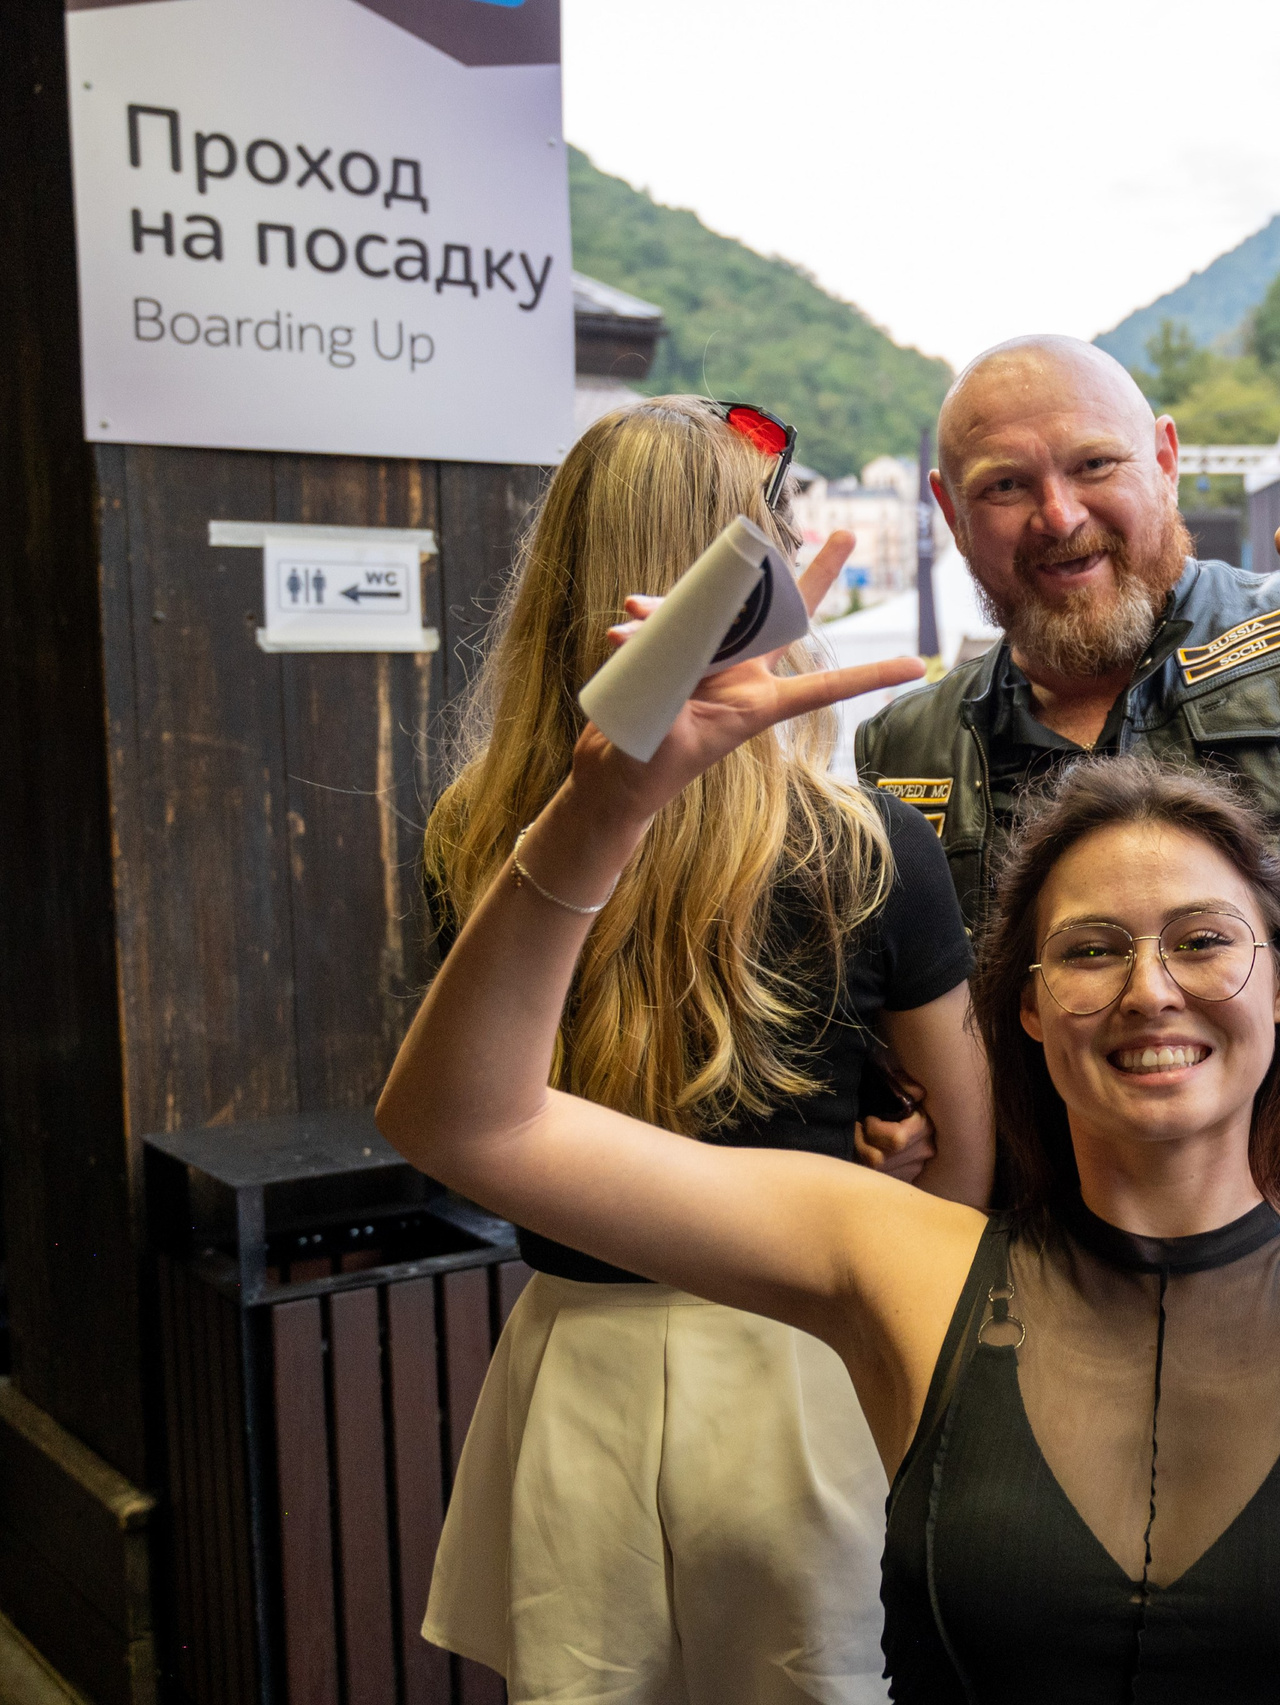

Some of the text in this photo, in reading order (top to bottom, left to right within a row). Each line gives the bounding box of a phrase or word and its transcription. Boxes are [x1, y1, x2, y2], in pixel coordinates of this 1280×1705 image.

[126, 103, 429, 213] Проход
[130, 208, 553, 311] на посадку
[133, 298, 436, 371] Boarding Up
[365, 570, 397, 586] WC
[1207, 621, 1265, 654] RUSSIA
[1219, 639, 1269, 667] SOCHI
[931, 785, 949, 798] MC
